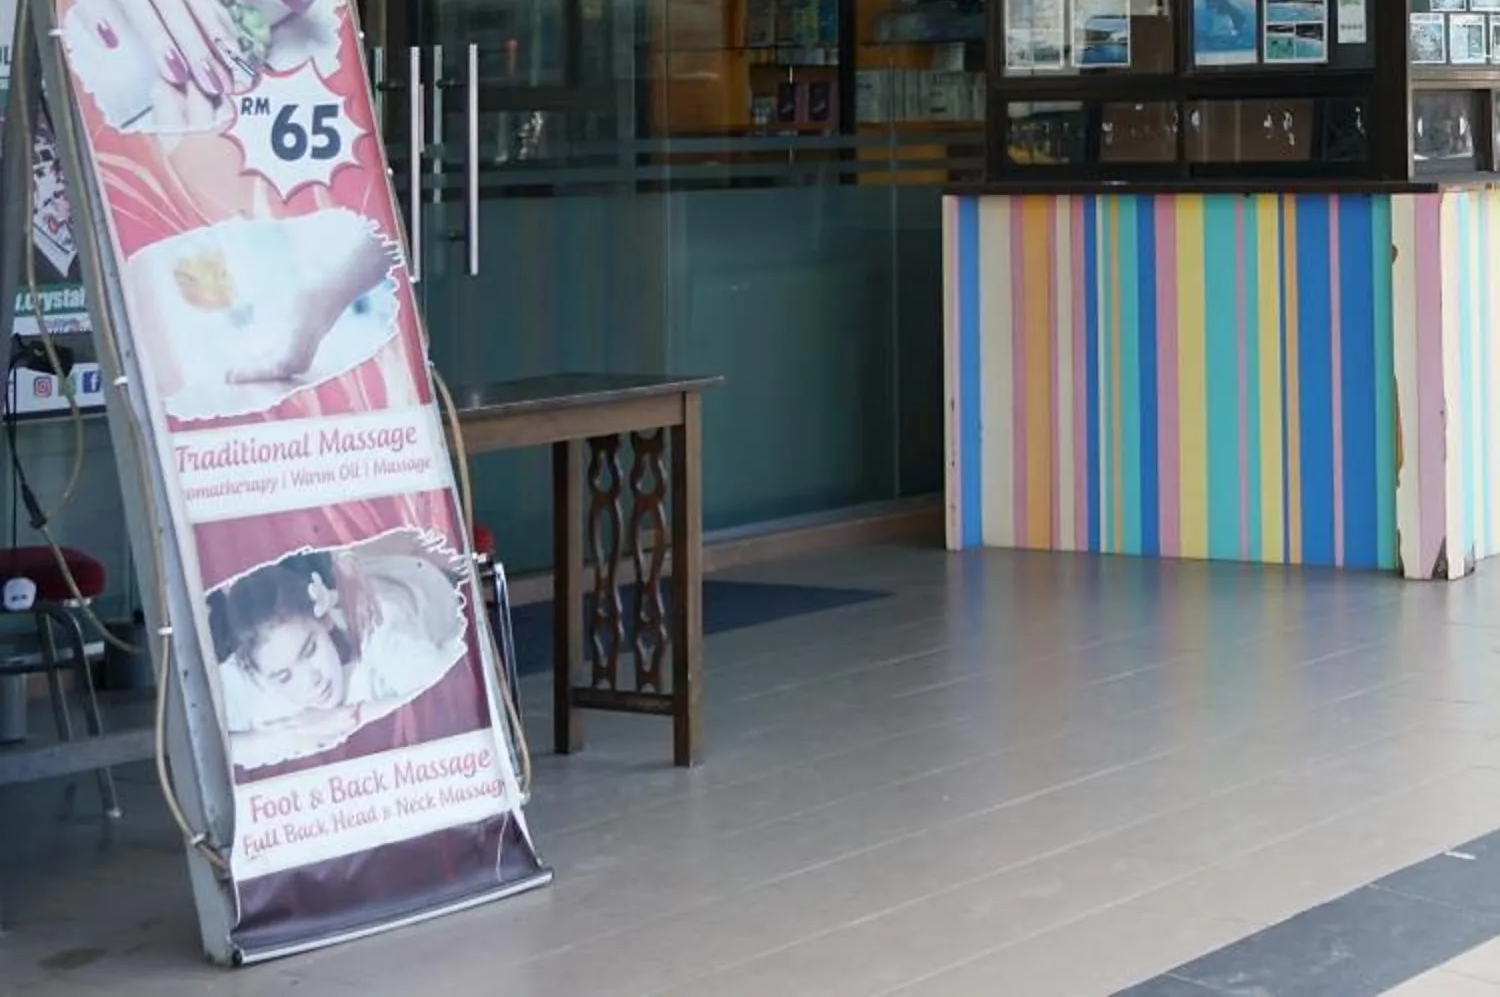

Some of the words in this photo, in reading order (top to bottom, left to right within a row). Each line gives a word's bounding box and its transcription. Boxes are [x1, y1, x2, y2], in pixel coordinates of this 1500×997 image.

[241, 96, 270, 116] RM
[271, 103, 342, 162] 65
[174, 432, 313, 474] Traditional
[318, 424, 418, 457] Massage
[373, 455, 433, 477] Massage
[248, 793, 303, 825] Foot
[328, 770, 386, 805] Back
[393, 747, 493, 788] Massage
[242, 828, 280, 857] Full
[284, 818, 328, 844] Back
[333, 806, 379, 833] Head
[396, 791, 438, 818] Neck
